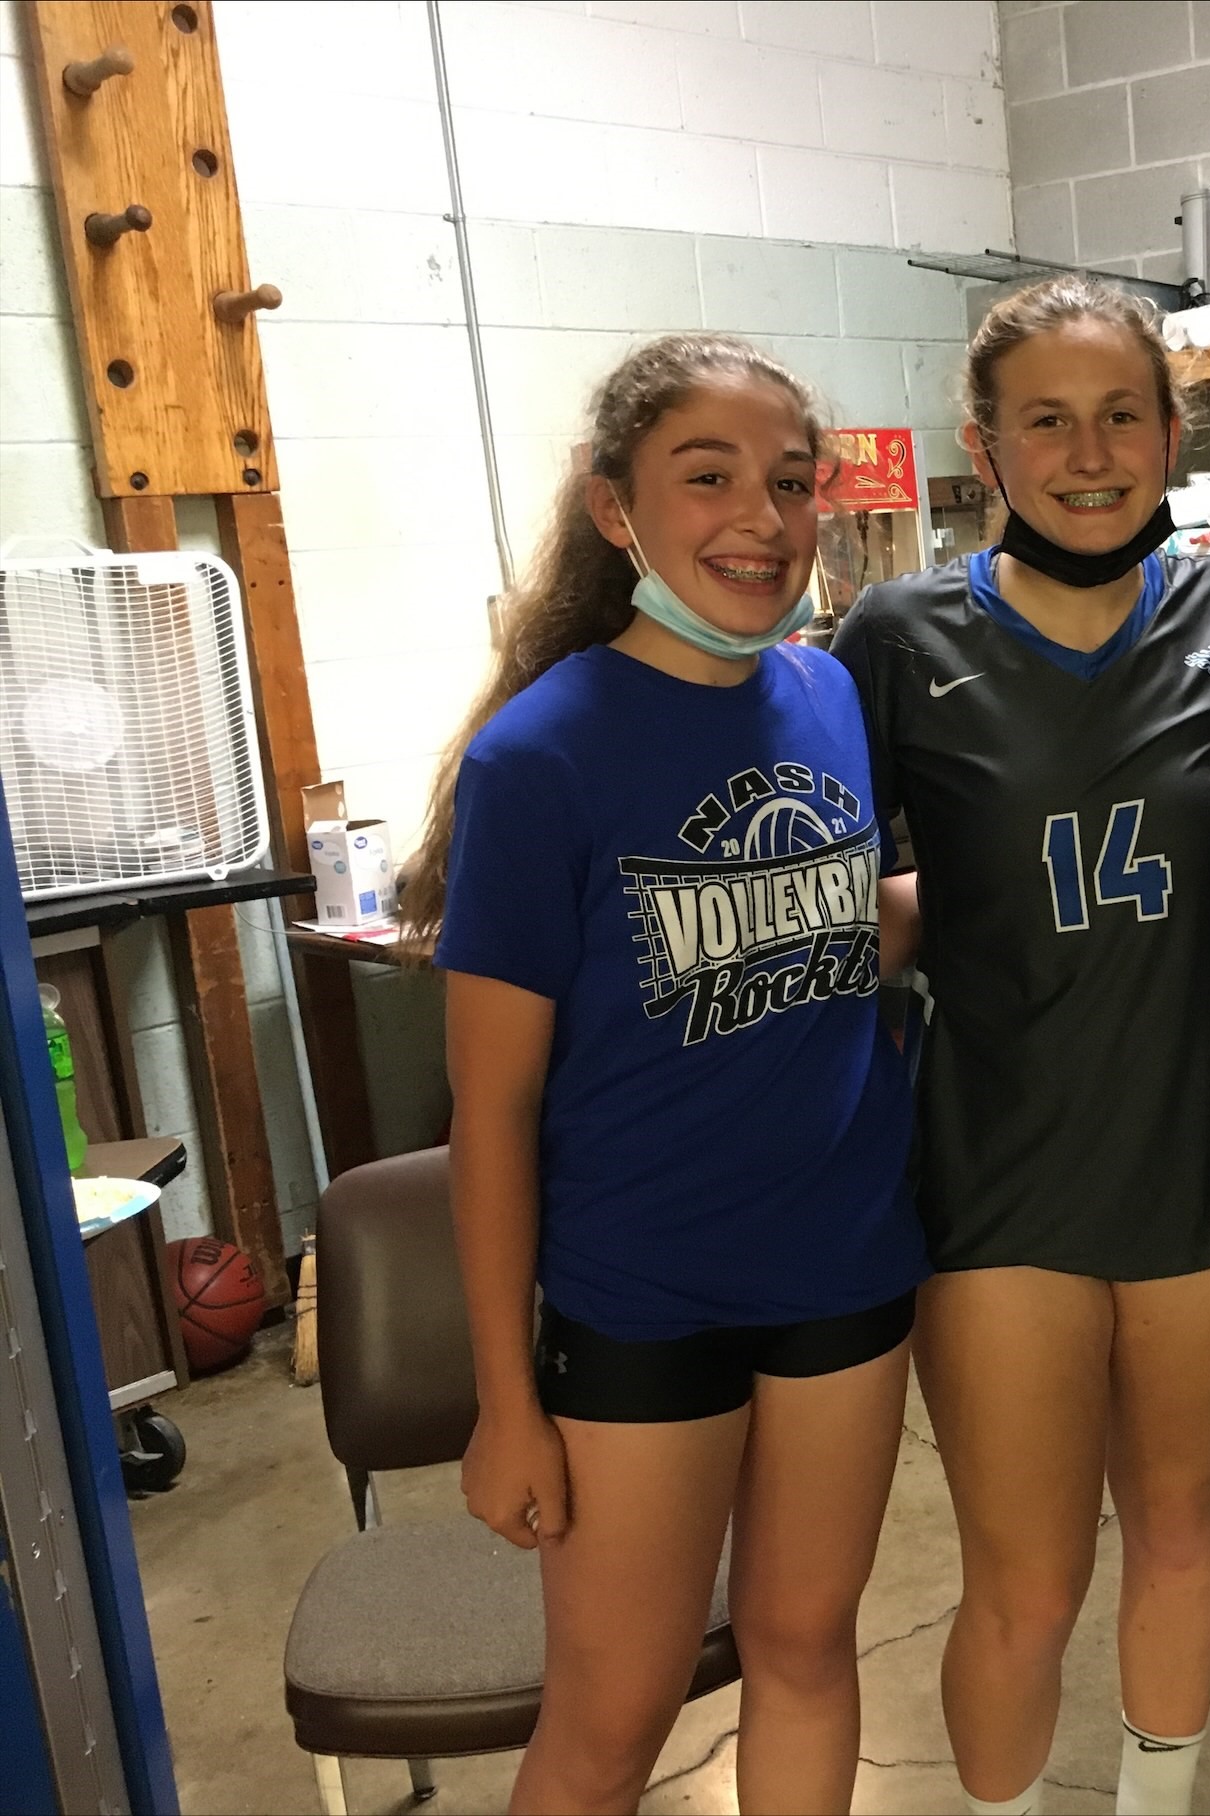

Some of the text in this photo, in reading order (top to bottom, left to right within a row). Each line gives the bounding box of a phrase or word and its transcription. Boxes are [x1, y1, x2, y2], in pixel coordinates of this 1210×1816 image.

[678, 761, 860, 854] NASH
[720, 837, 741, 858] 20
[831, 817, 847, 835] 21
[1041, 798, 1174, 933] 14
[650, 846, 880, 979] VOLLEYBAL
